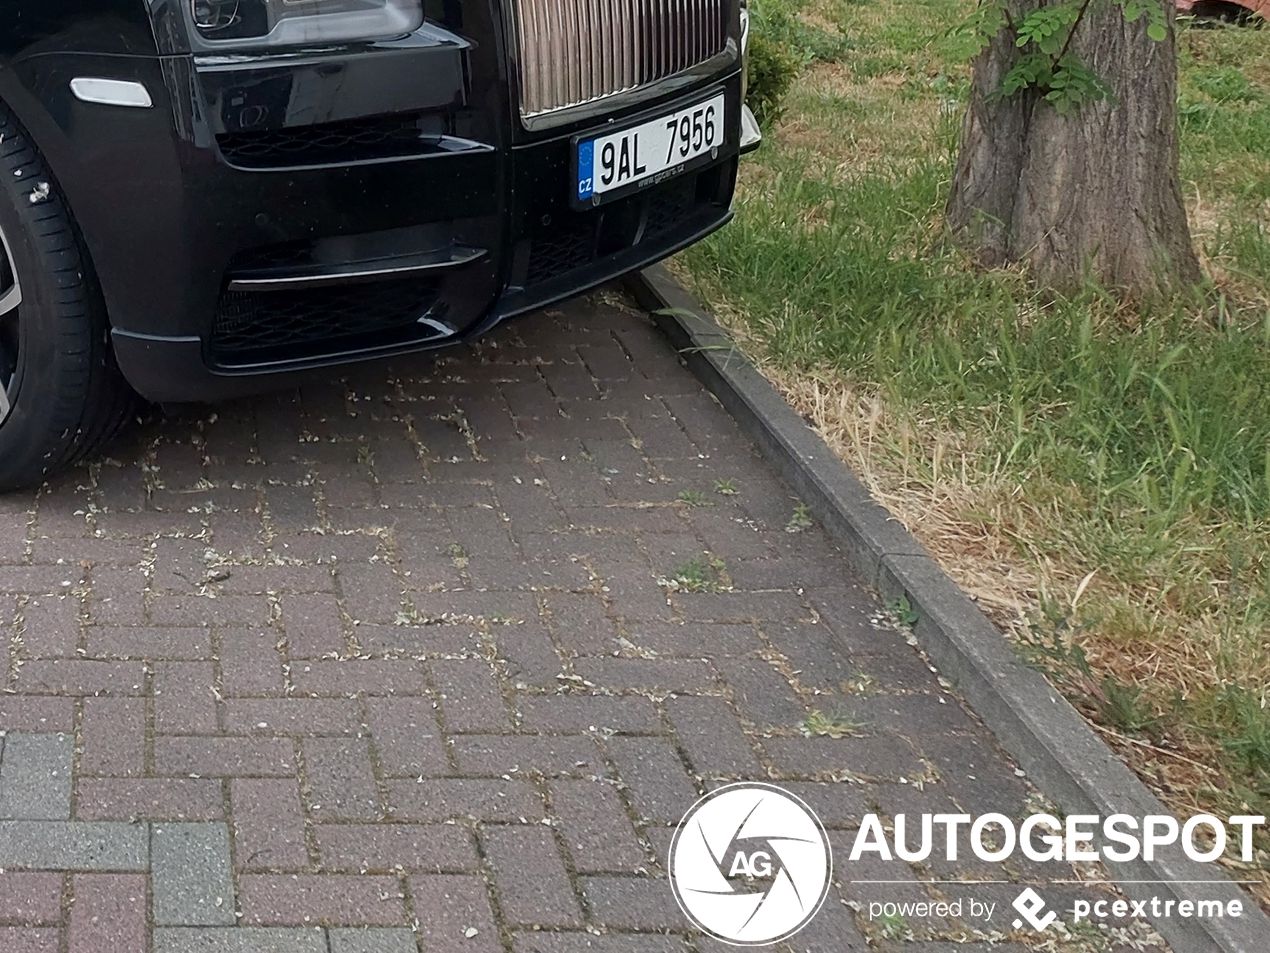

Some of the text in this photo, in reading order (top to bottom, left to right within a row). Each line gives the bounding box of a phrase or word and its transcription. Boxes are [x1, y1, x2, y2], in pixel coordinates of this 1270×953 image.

[601, 105, 715, 186] 9AL 7956
[578, 177, 592, 194] CZ
